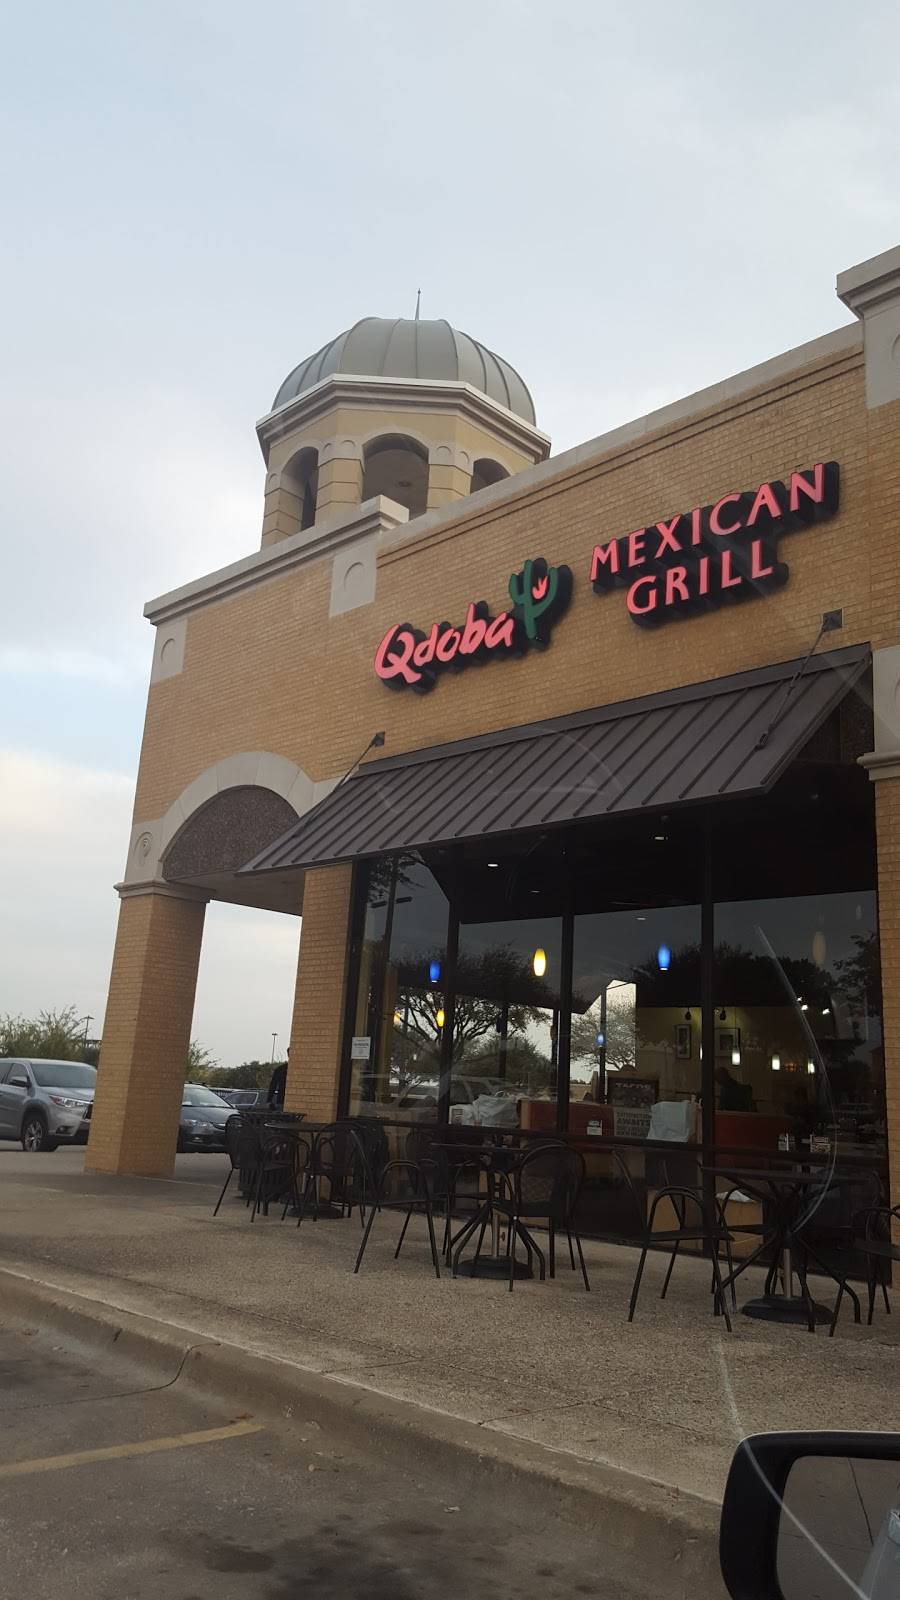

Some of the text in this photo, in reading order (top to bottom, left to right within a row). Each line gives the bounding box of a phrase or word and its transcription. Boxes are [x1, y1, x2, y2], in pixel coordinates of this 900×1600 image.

[590, 463, 825, 582] MEXICAN
[626, 539, 774, 615] GRILL
[374, 602, 515, 684] Qdoba
